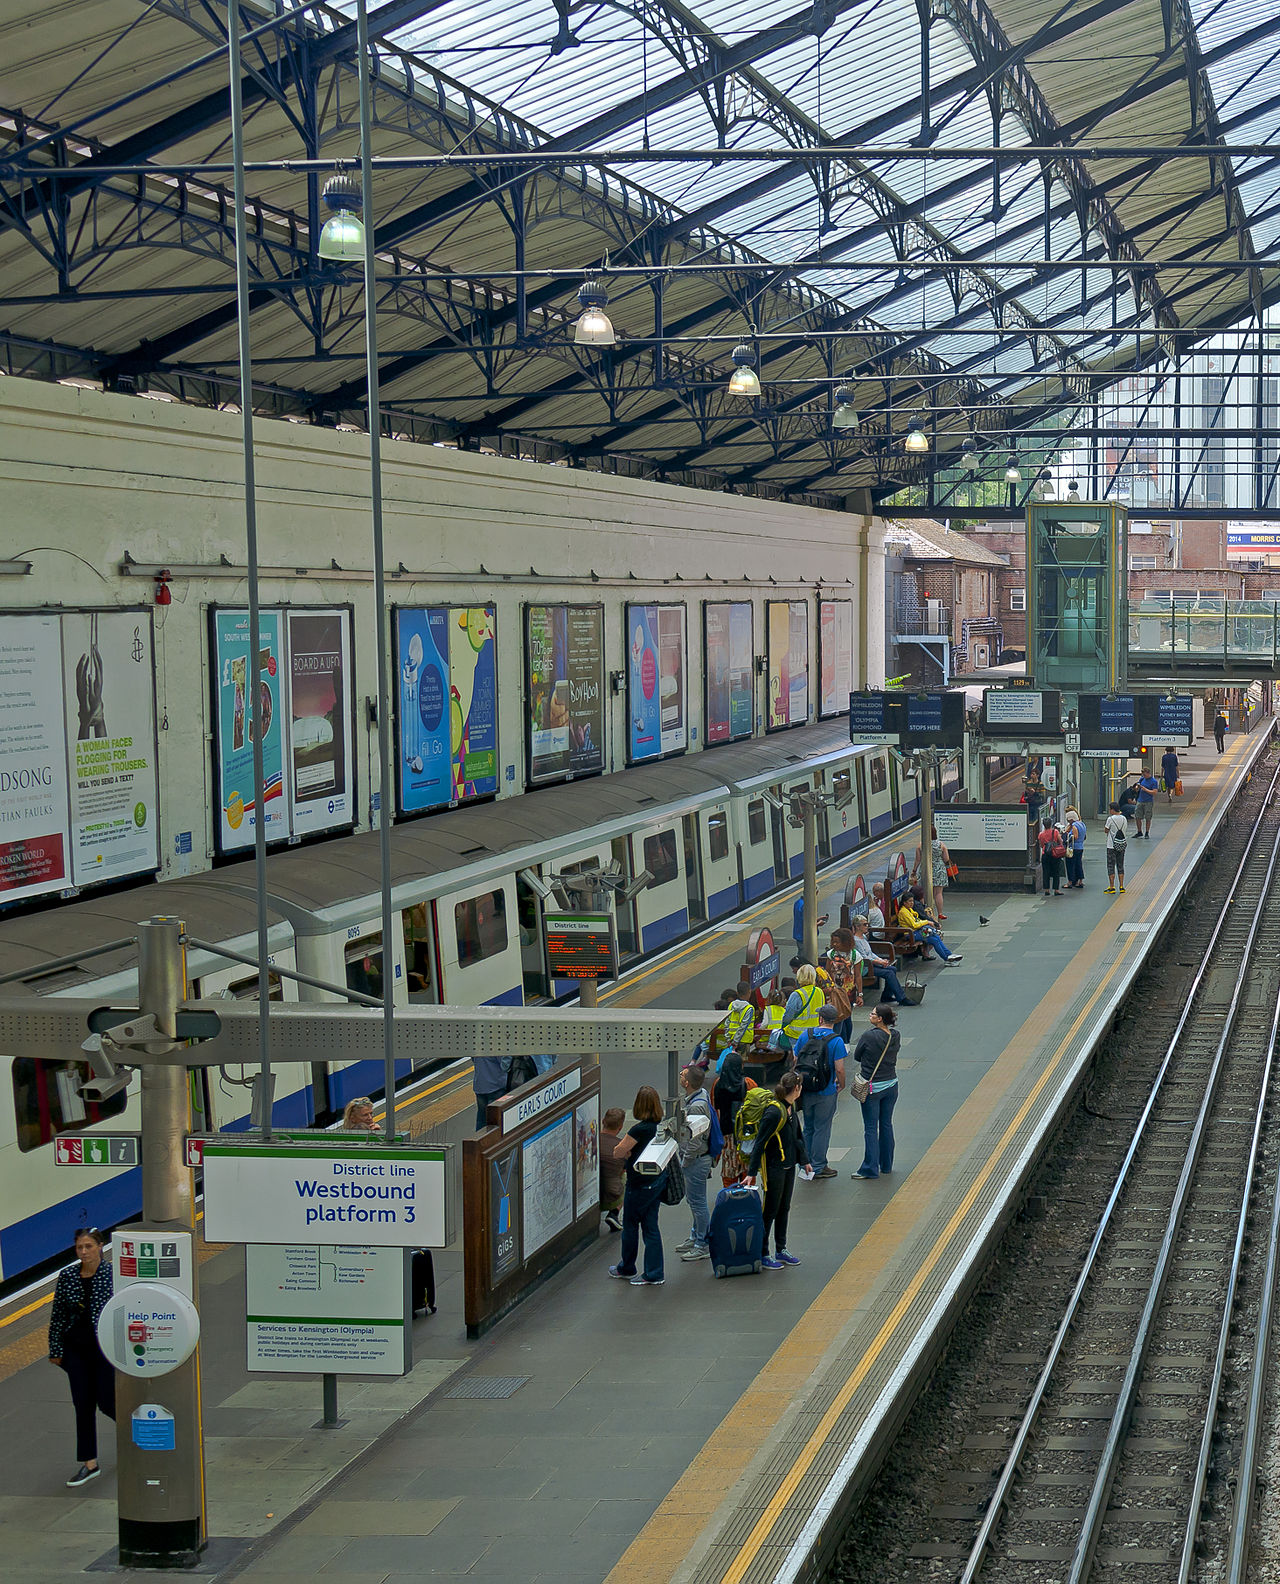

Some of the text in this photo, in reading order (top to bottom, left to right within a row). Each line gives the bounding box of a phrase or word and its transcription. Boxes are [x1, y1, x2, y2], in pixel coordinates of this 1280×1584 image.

[294, 658, 318, 670] BOARD
[320, 656, 325, 669] A
[76, 737, 132, 753] A WOMAN FACES
[1069, 734, 1077, 743] H
[76, 750, 127, 766] FLOGGING FOR
[77, 765, 110, 778] WEARING
[78, 780, 90, 789] WILL
[90, 778, 100, 787] YOU
[101, 776, 114, 786] SEND
[25, 806, 53, 817] FAULKS
[544, 1080, 567, 1105] COURT
[333, 1164, 415, 1176] District line
[295, 1181, 415, 1199] Westbound
[306, 1205, 416, 1225] platform 3
[498, 1236, 514, 1256] GIGS
[128, 1312, 176, 1321] Help Point
[258, 1324, 286, 1332] Services
[298, 1326, 339, 1334] Kensington
